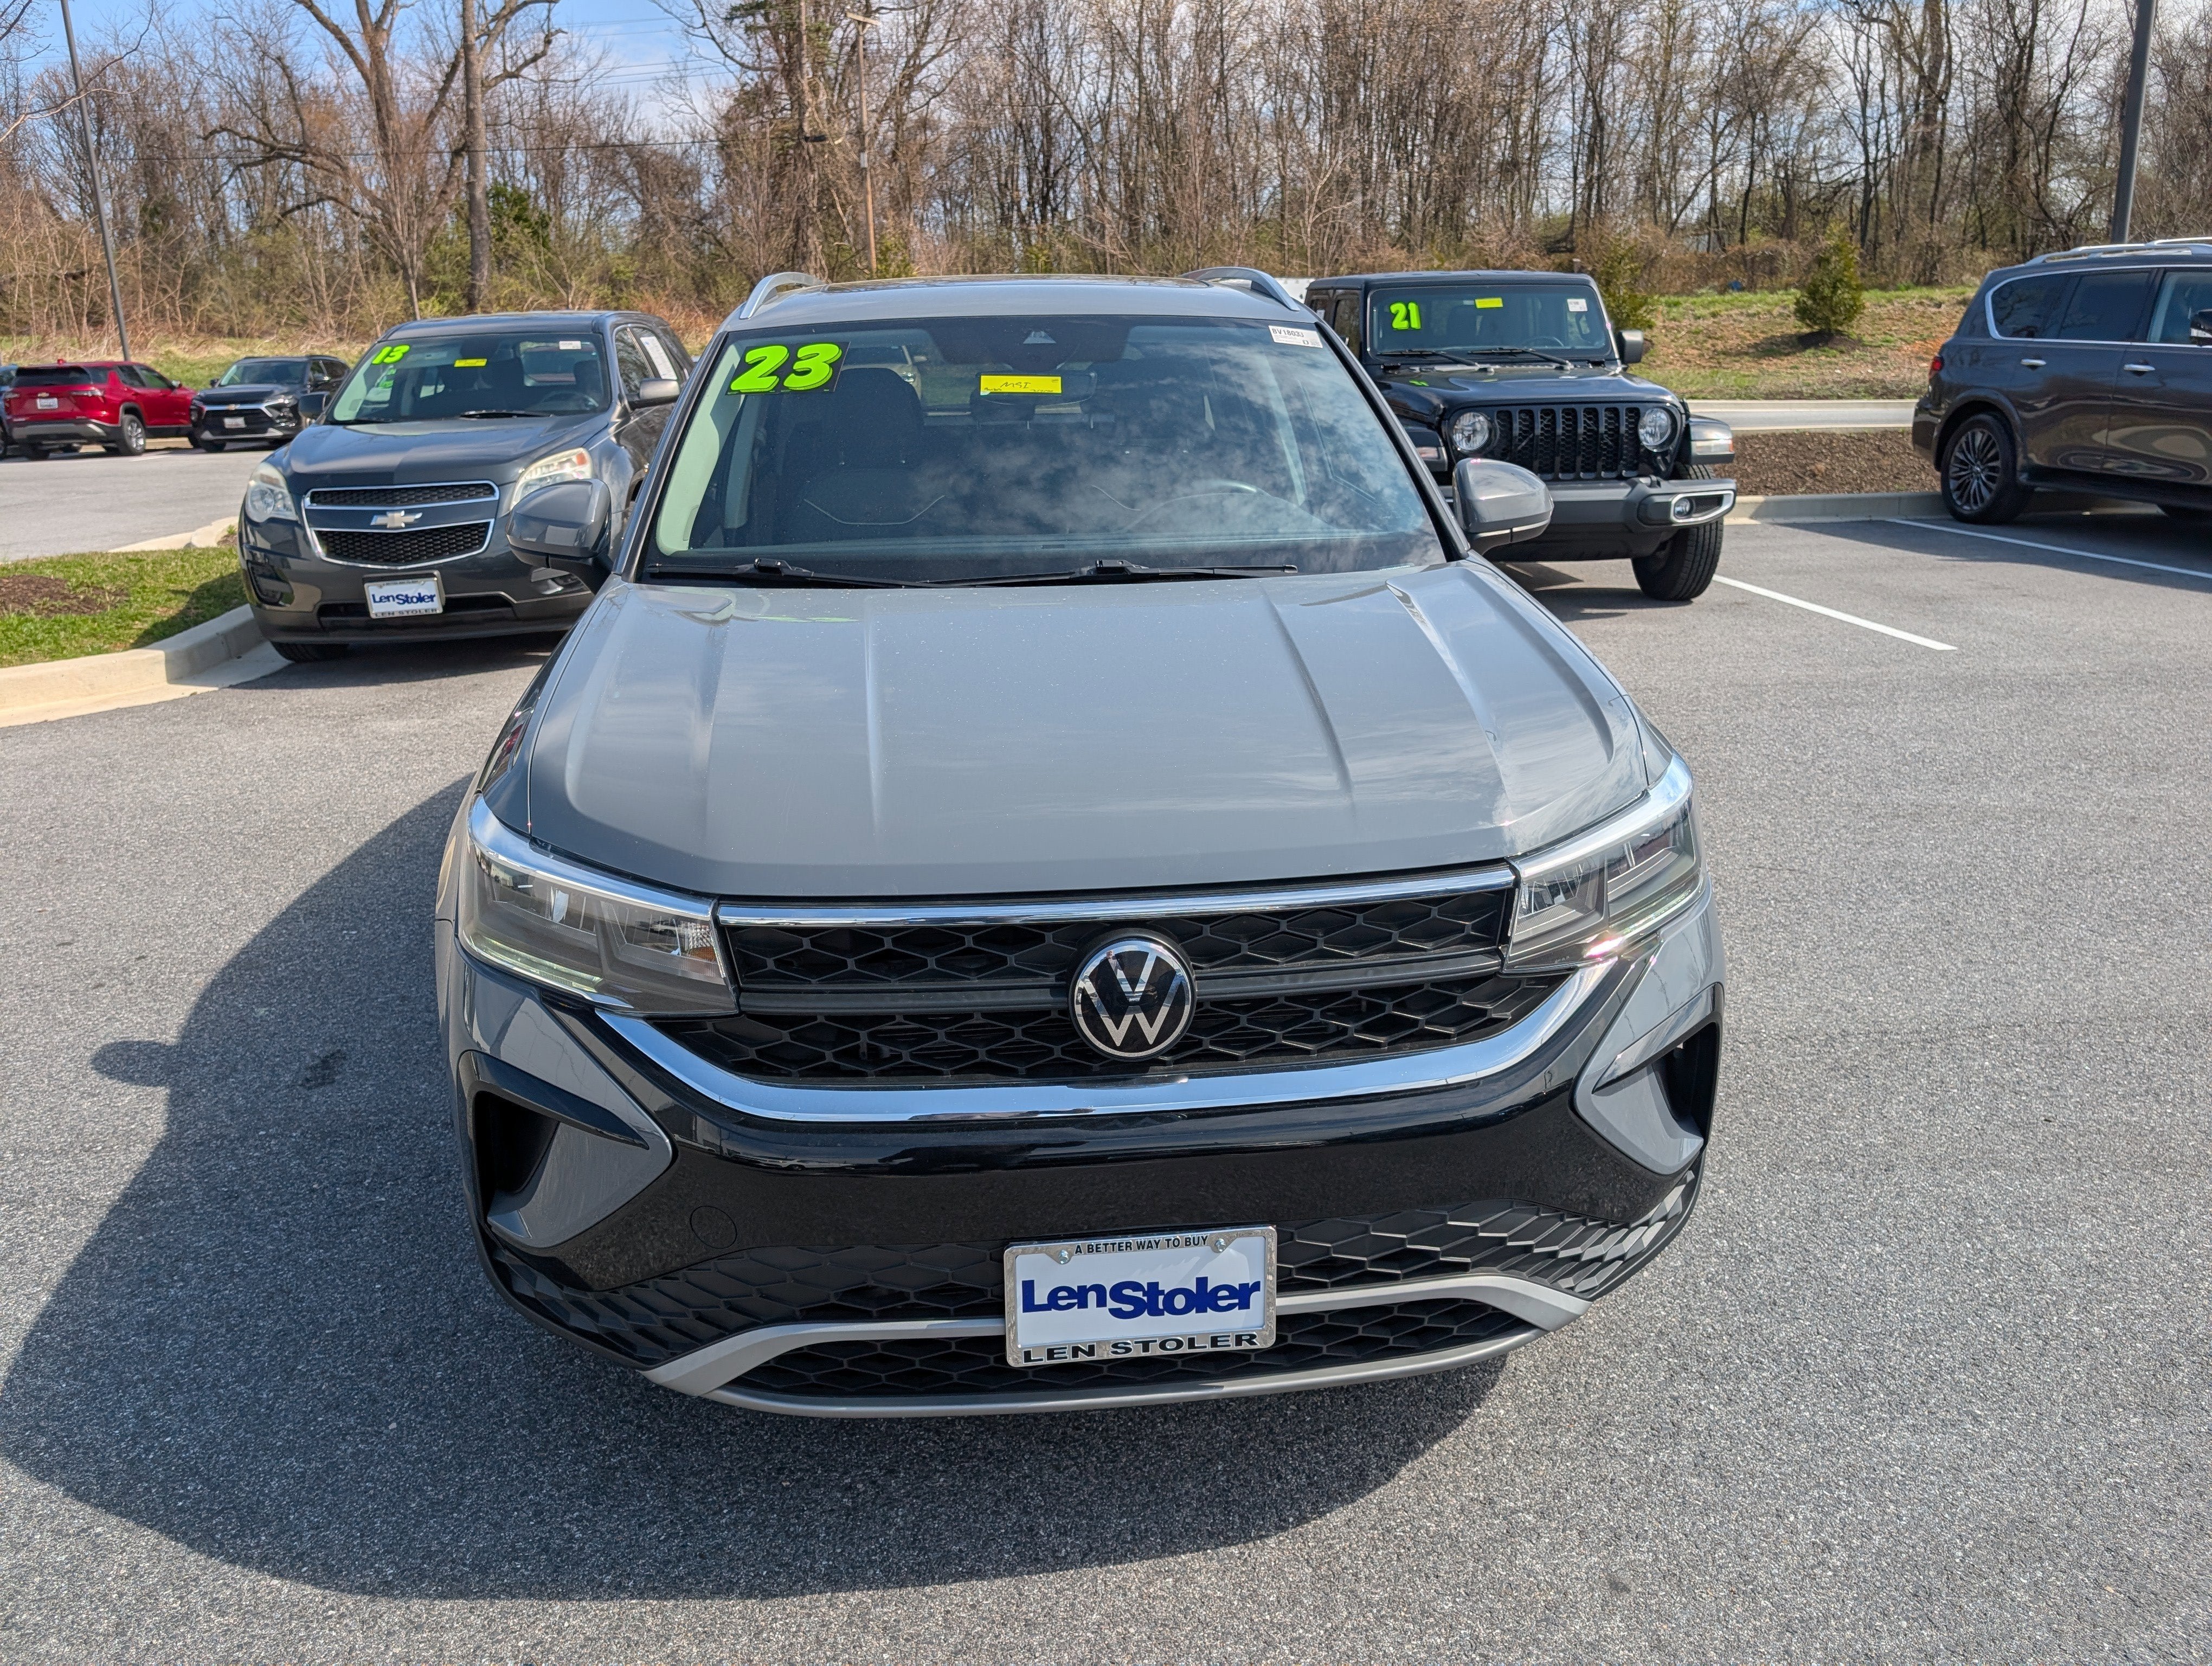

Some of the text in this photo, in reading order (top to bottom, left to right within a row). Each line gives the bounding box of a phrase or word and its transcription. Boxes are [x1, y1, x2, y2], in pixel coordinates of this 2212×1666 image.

[1390, 302, 1422, 330] 21
[371, 344, 411, 365] 13
[730, 343, 843, 393] 23
[1075, 1234, 1208, 1254] A BETTER WAY TO BUY
[1023, 1332, 1259, 1364] LEN STOLER
